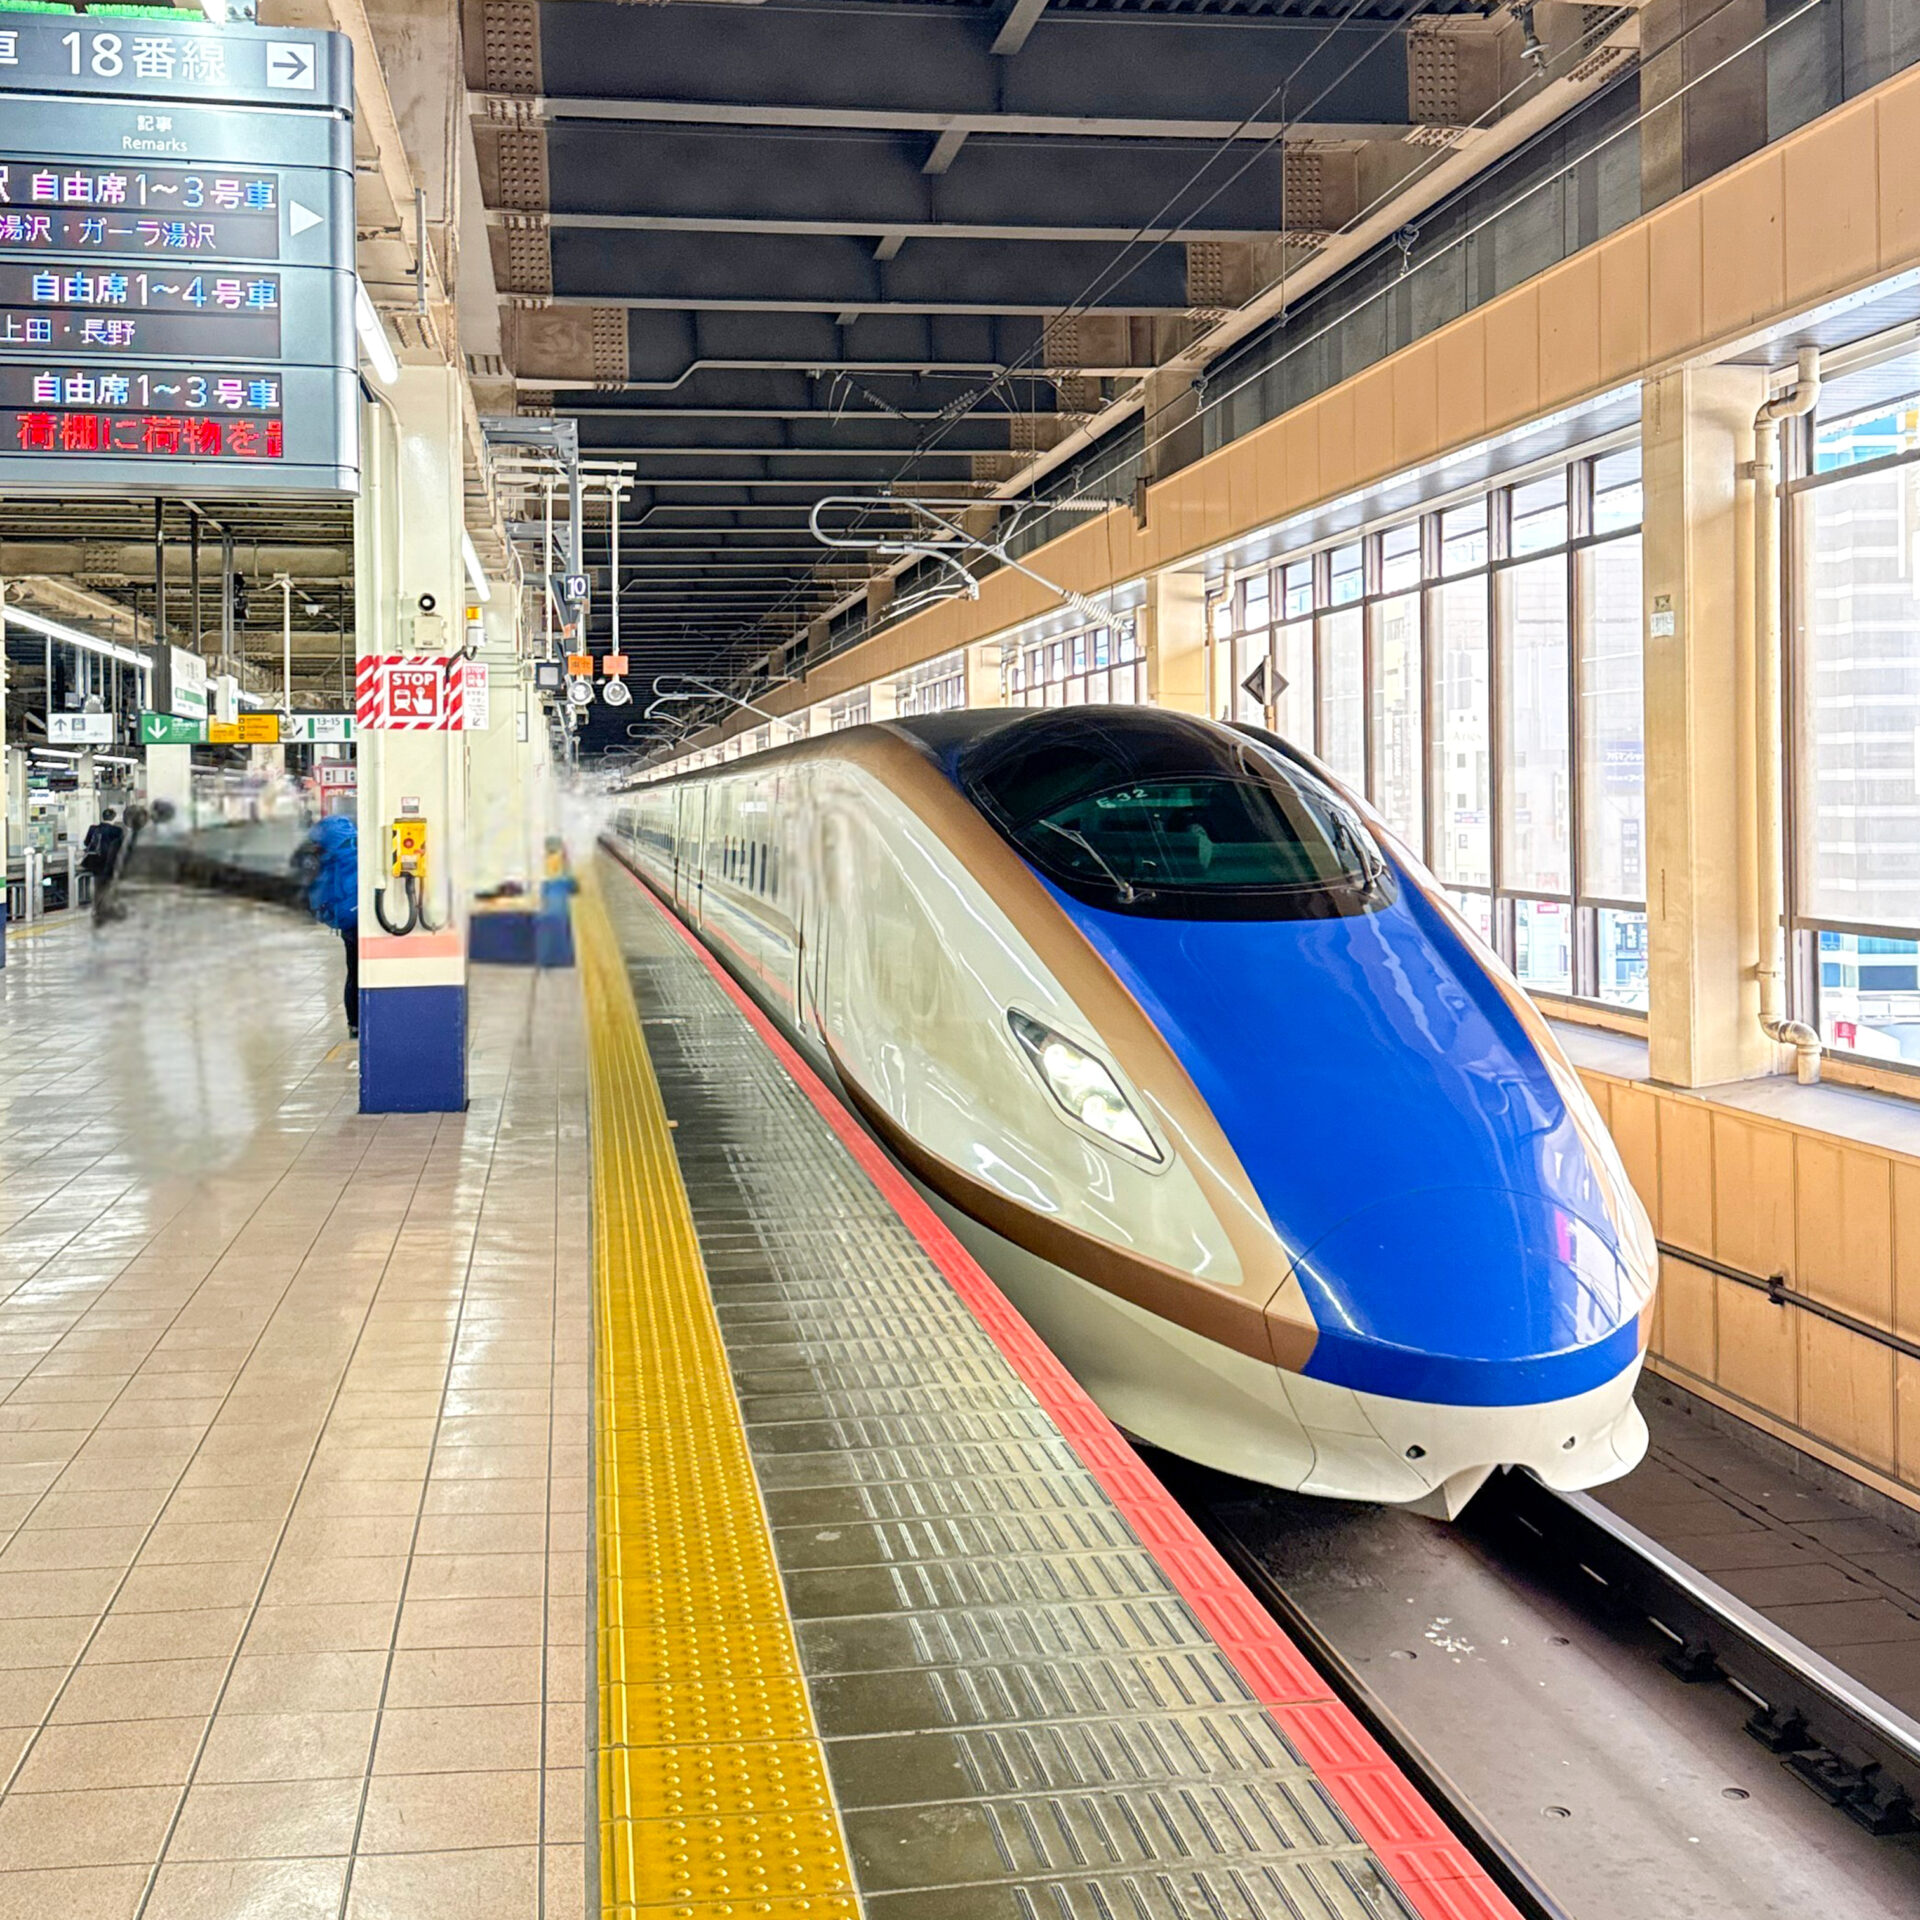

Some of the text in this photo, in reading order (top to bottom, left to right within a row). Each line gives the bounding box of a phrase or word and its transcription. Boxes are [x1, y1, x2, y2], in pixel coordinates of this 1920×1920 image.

[62, 31, 226, 82] 18番線
[137, 115, 173, 132] 記事
[122, 136, 188, 152] Remarks
[567, 577, 587, 597] 10
[392, 673, 435, 686] STOP
